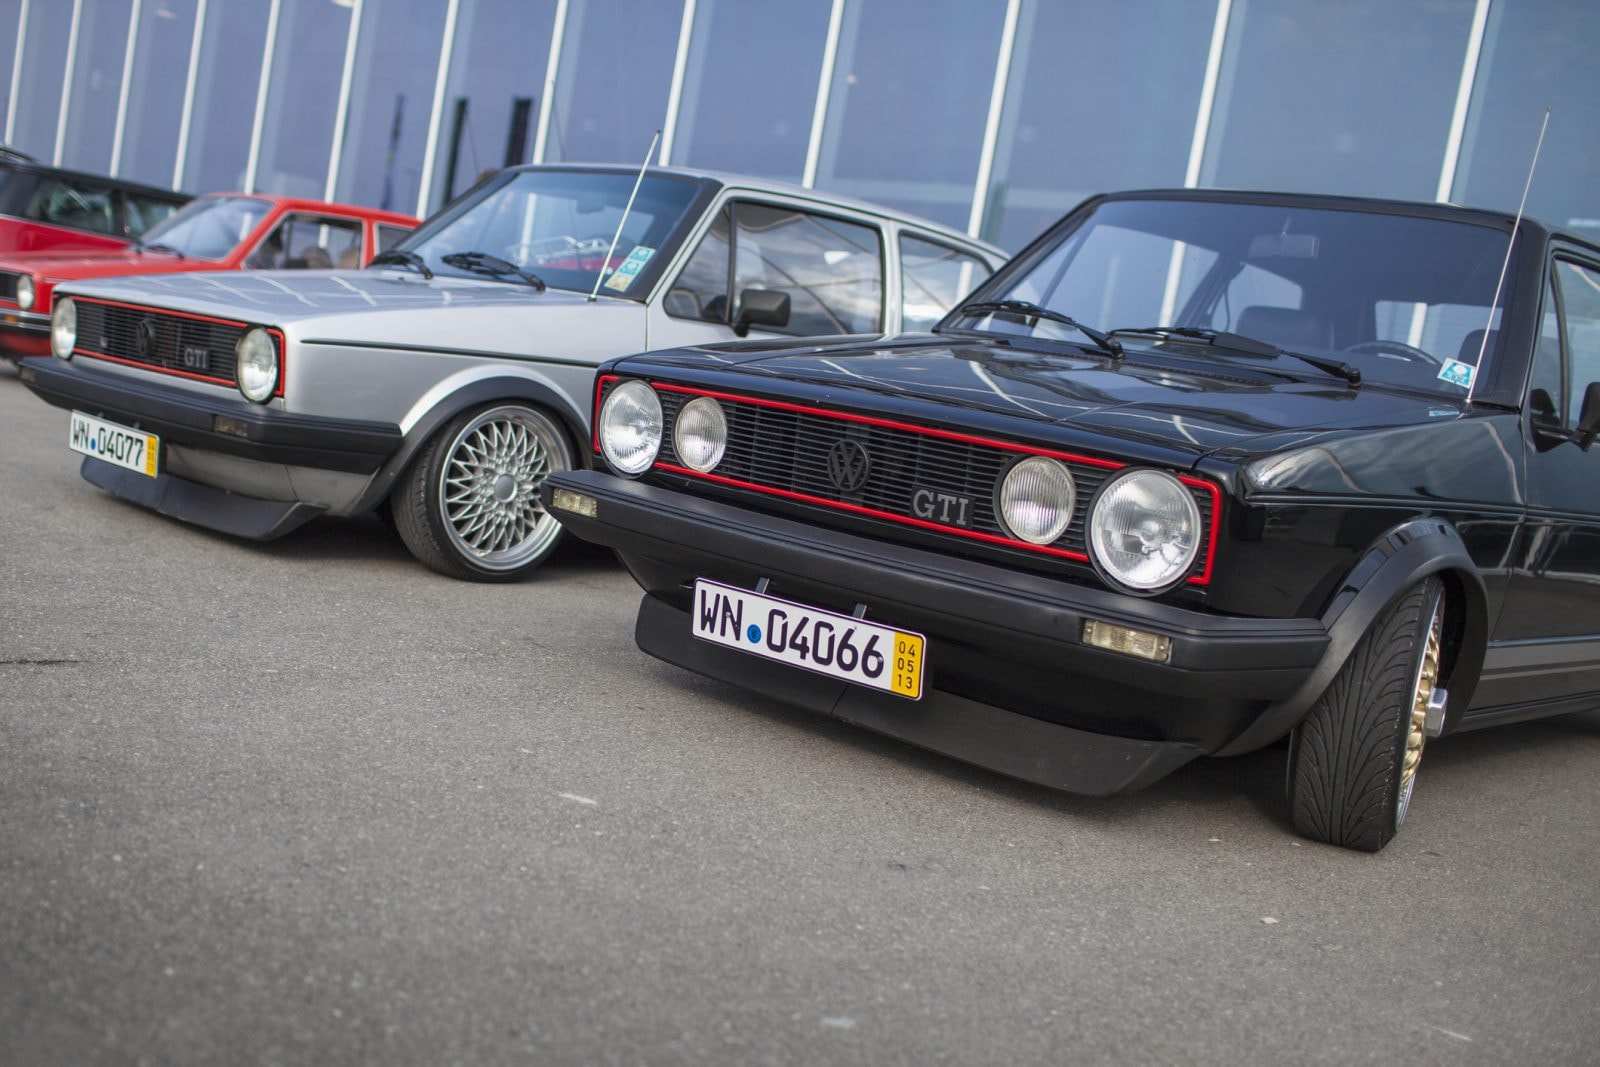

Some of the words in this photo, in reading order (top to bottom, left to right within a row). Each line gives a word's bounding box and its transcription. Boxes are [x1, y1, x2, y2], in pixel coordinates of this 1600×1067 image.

[184, 347, 208, 369] GTI
[73, 418, 90, 450] WN
[98, 427, 144, 467] 04077
[913, 489, 969, 526] GTI
[700, 589, 743, 641] WN
[766, 608, 885, 679] 04066
[898, 641, 916, 657] 04
[897, 658, 914, 673] 05
[897, 673, 913, 689] 13
